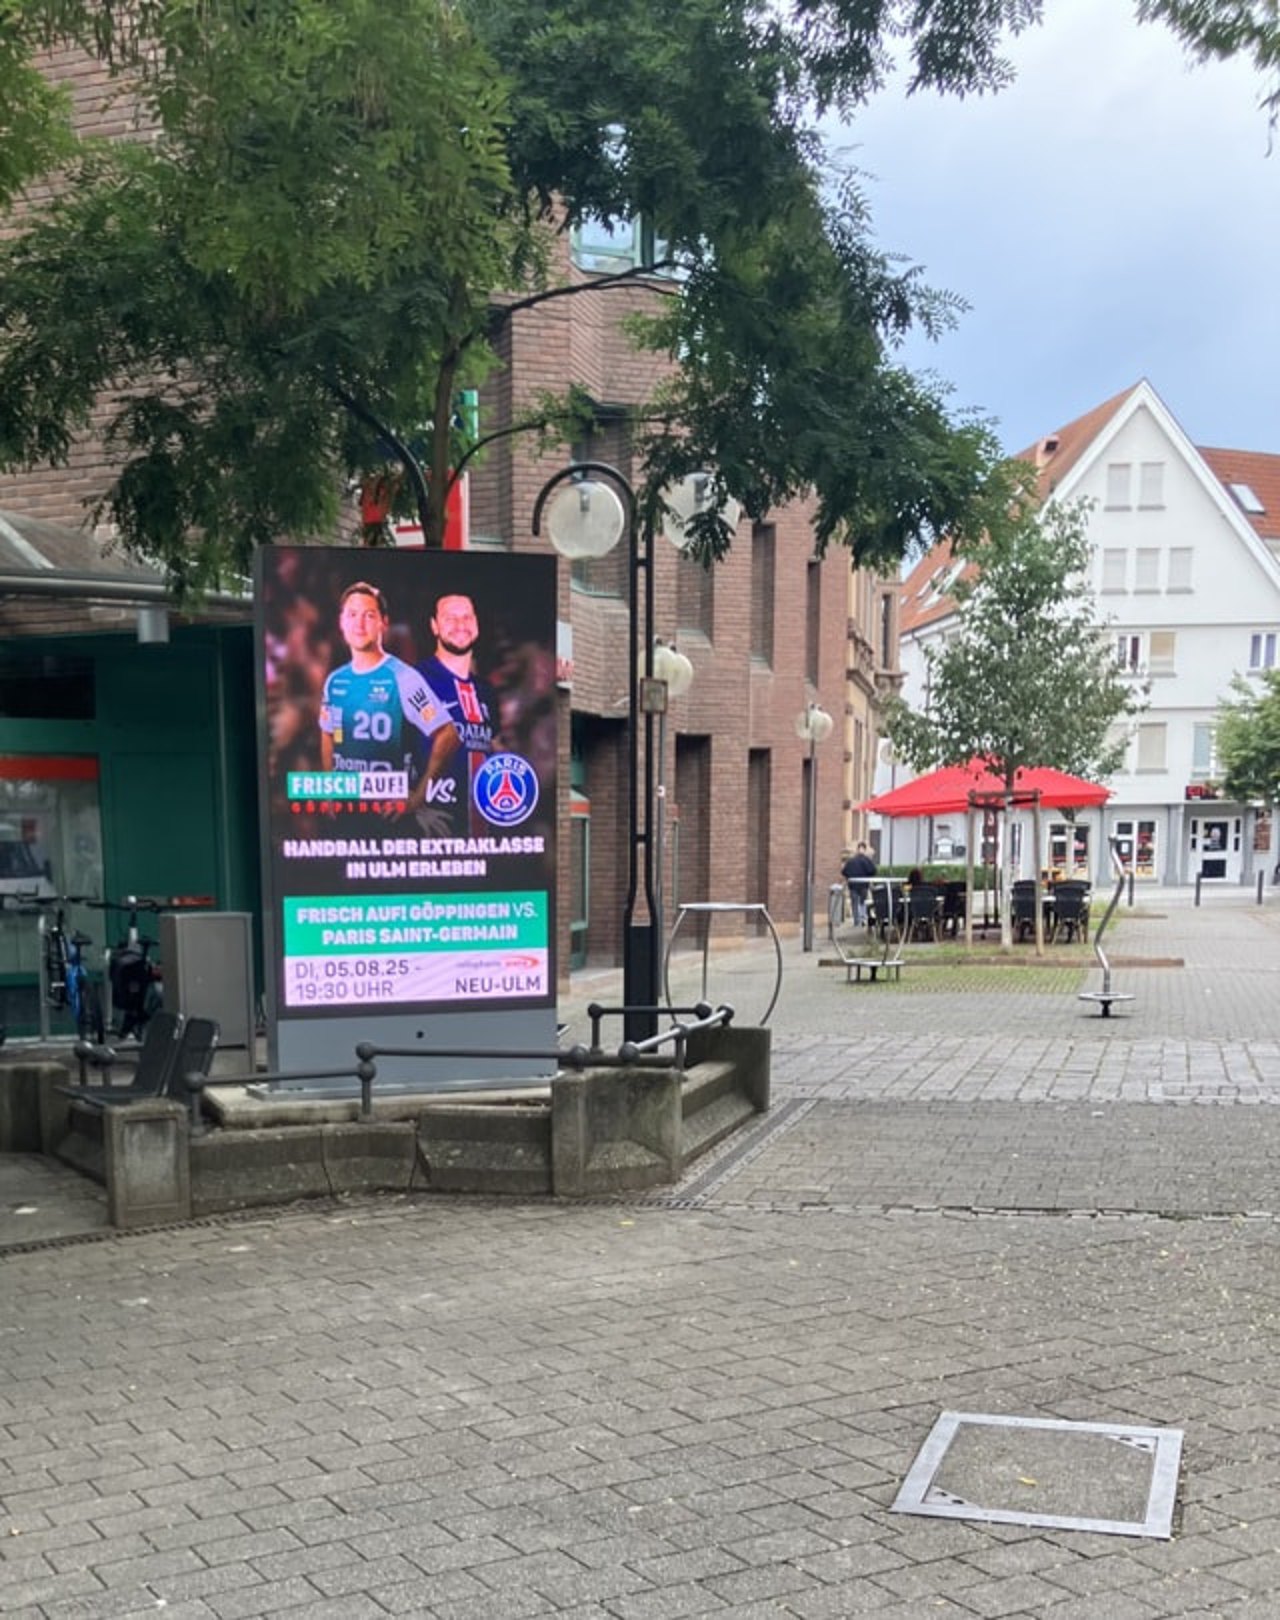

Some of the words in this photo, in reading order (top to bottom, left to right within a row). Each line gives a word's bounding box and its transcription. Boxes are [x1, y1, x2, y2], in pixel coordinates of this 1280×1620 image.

[352, 710, 392, 741] 20
[485, 757, 528, 776] PARIS
[292, 777, 357, 794] FRISCH
[363, 776, 403, 793] AUF!
[425, 778, 457, 803] VS.
[283, 840, 379, 857] HANDBALL
[380, 839, 418, 855] DER
[420, 837, 544, 854] EXTRAKLASSE
[346, 862, 366, 878] IN
[368, 861, 407, 878] ULM
[408, 860, 486, 876] ERLEBEN
[297, 907, 363, 923] FRISCH
[365, 906, 406, 922] AUF!
[409, 901, 510, 920] GÖPPINGEN
[512, 902, 538, 918] VS.
[322, 929, 376, 945] PARIS
[379, 925, 518, 943] SAINT-GERMAIN
[295, 962, 320, 981] DI,
[324, 960, 409, 977] 05.08.25
[296, 982, 348, 1000] 19:30
[353, 981, 394, 997] UHR
[455, 976, 541, 993] NEU-ULM
